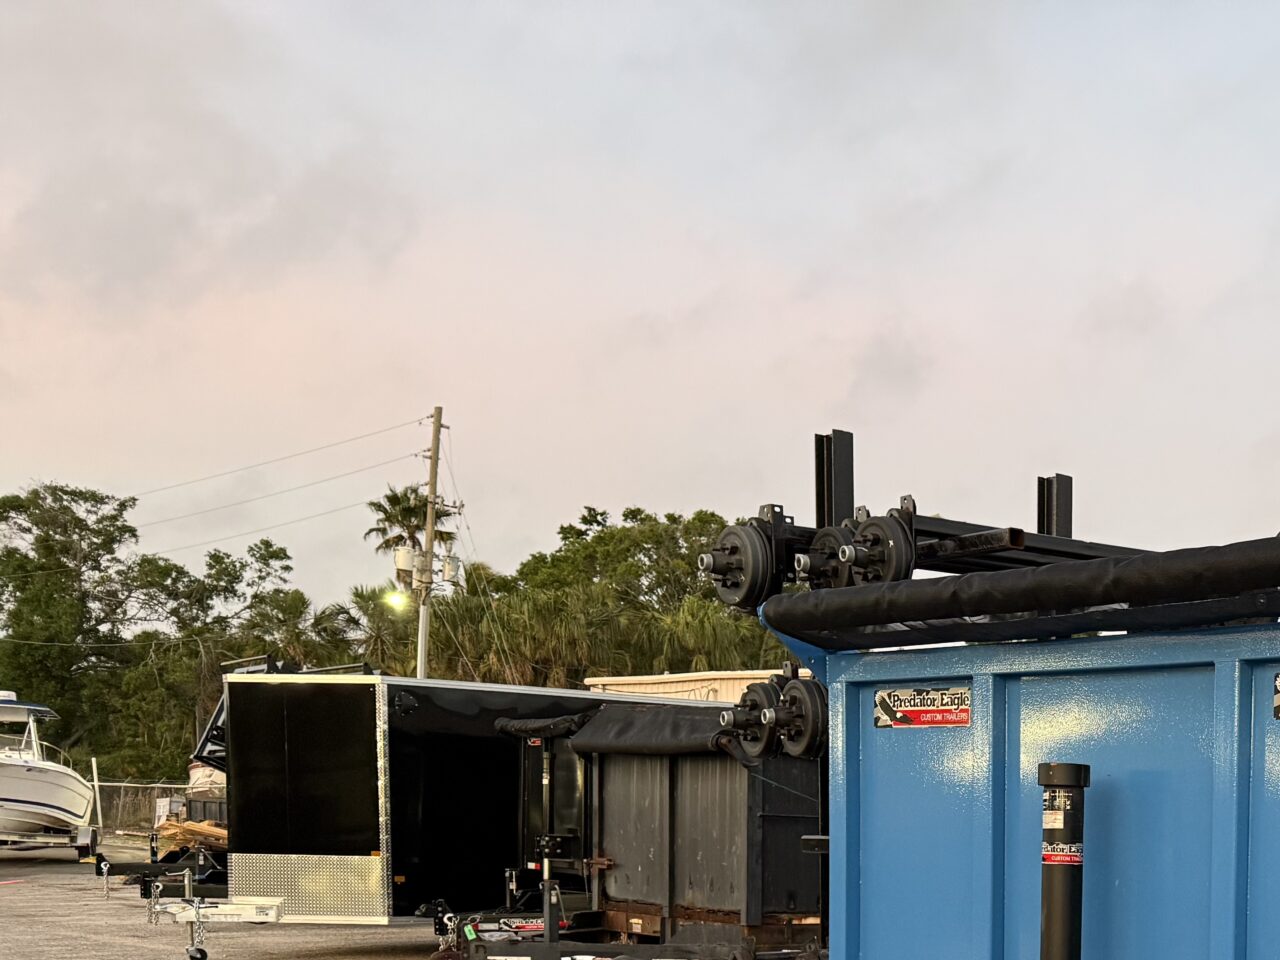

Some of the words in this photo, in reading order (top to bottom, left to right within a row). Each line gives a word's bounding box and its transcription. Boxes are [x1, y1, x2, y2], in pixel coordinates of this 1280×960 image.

[892, 693, 936, 709] Predator
[940, 691, 969, 711] Eagle
[921, 713, 943, 721] CUSTOM
[943, 712, 968, 720] TRAILERS
